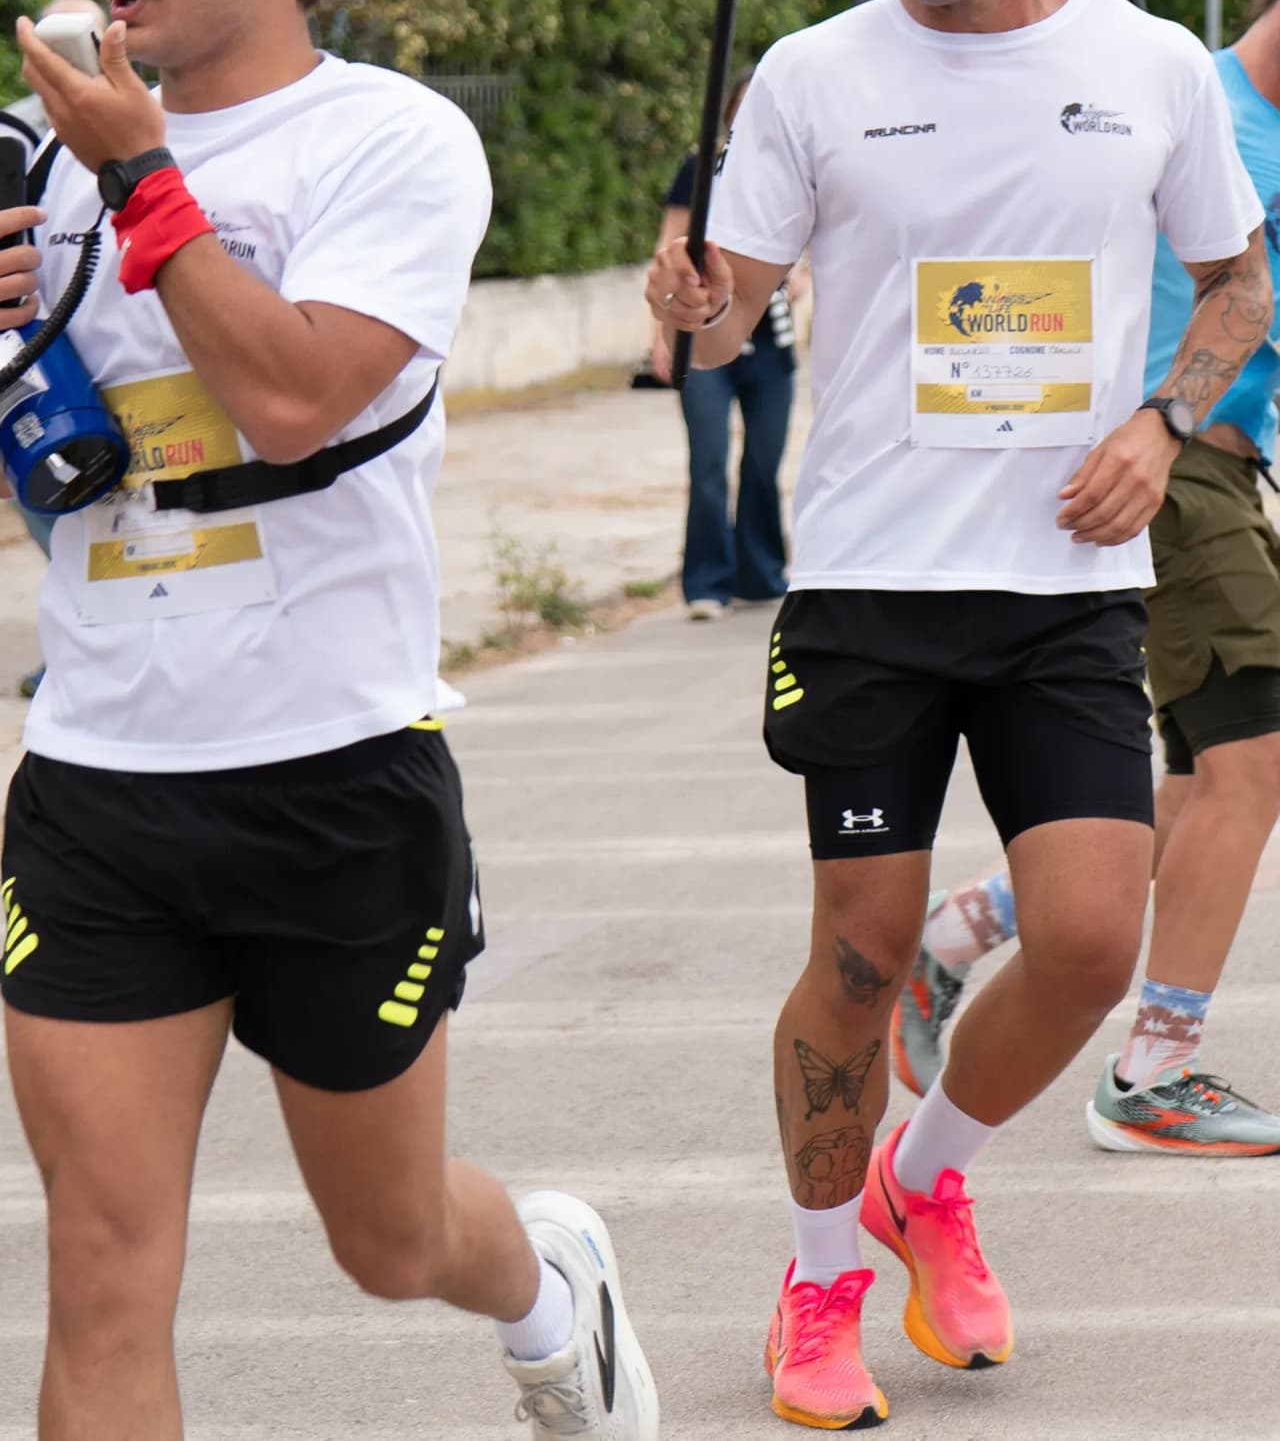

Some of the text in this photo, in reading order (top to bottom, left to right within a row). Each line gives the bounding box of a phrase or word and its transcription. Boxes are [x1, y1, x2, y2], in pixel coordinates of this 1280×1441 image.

[1073, 118, 1133, 136] WORLD RUN
[968, 313, 1064, 333] WORLD RUN
[165, 438, 205, 466] RUN
